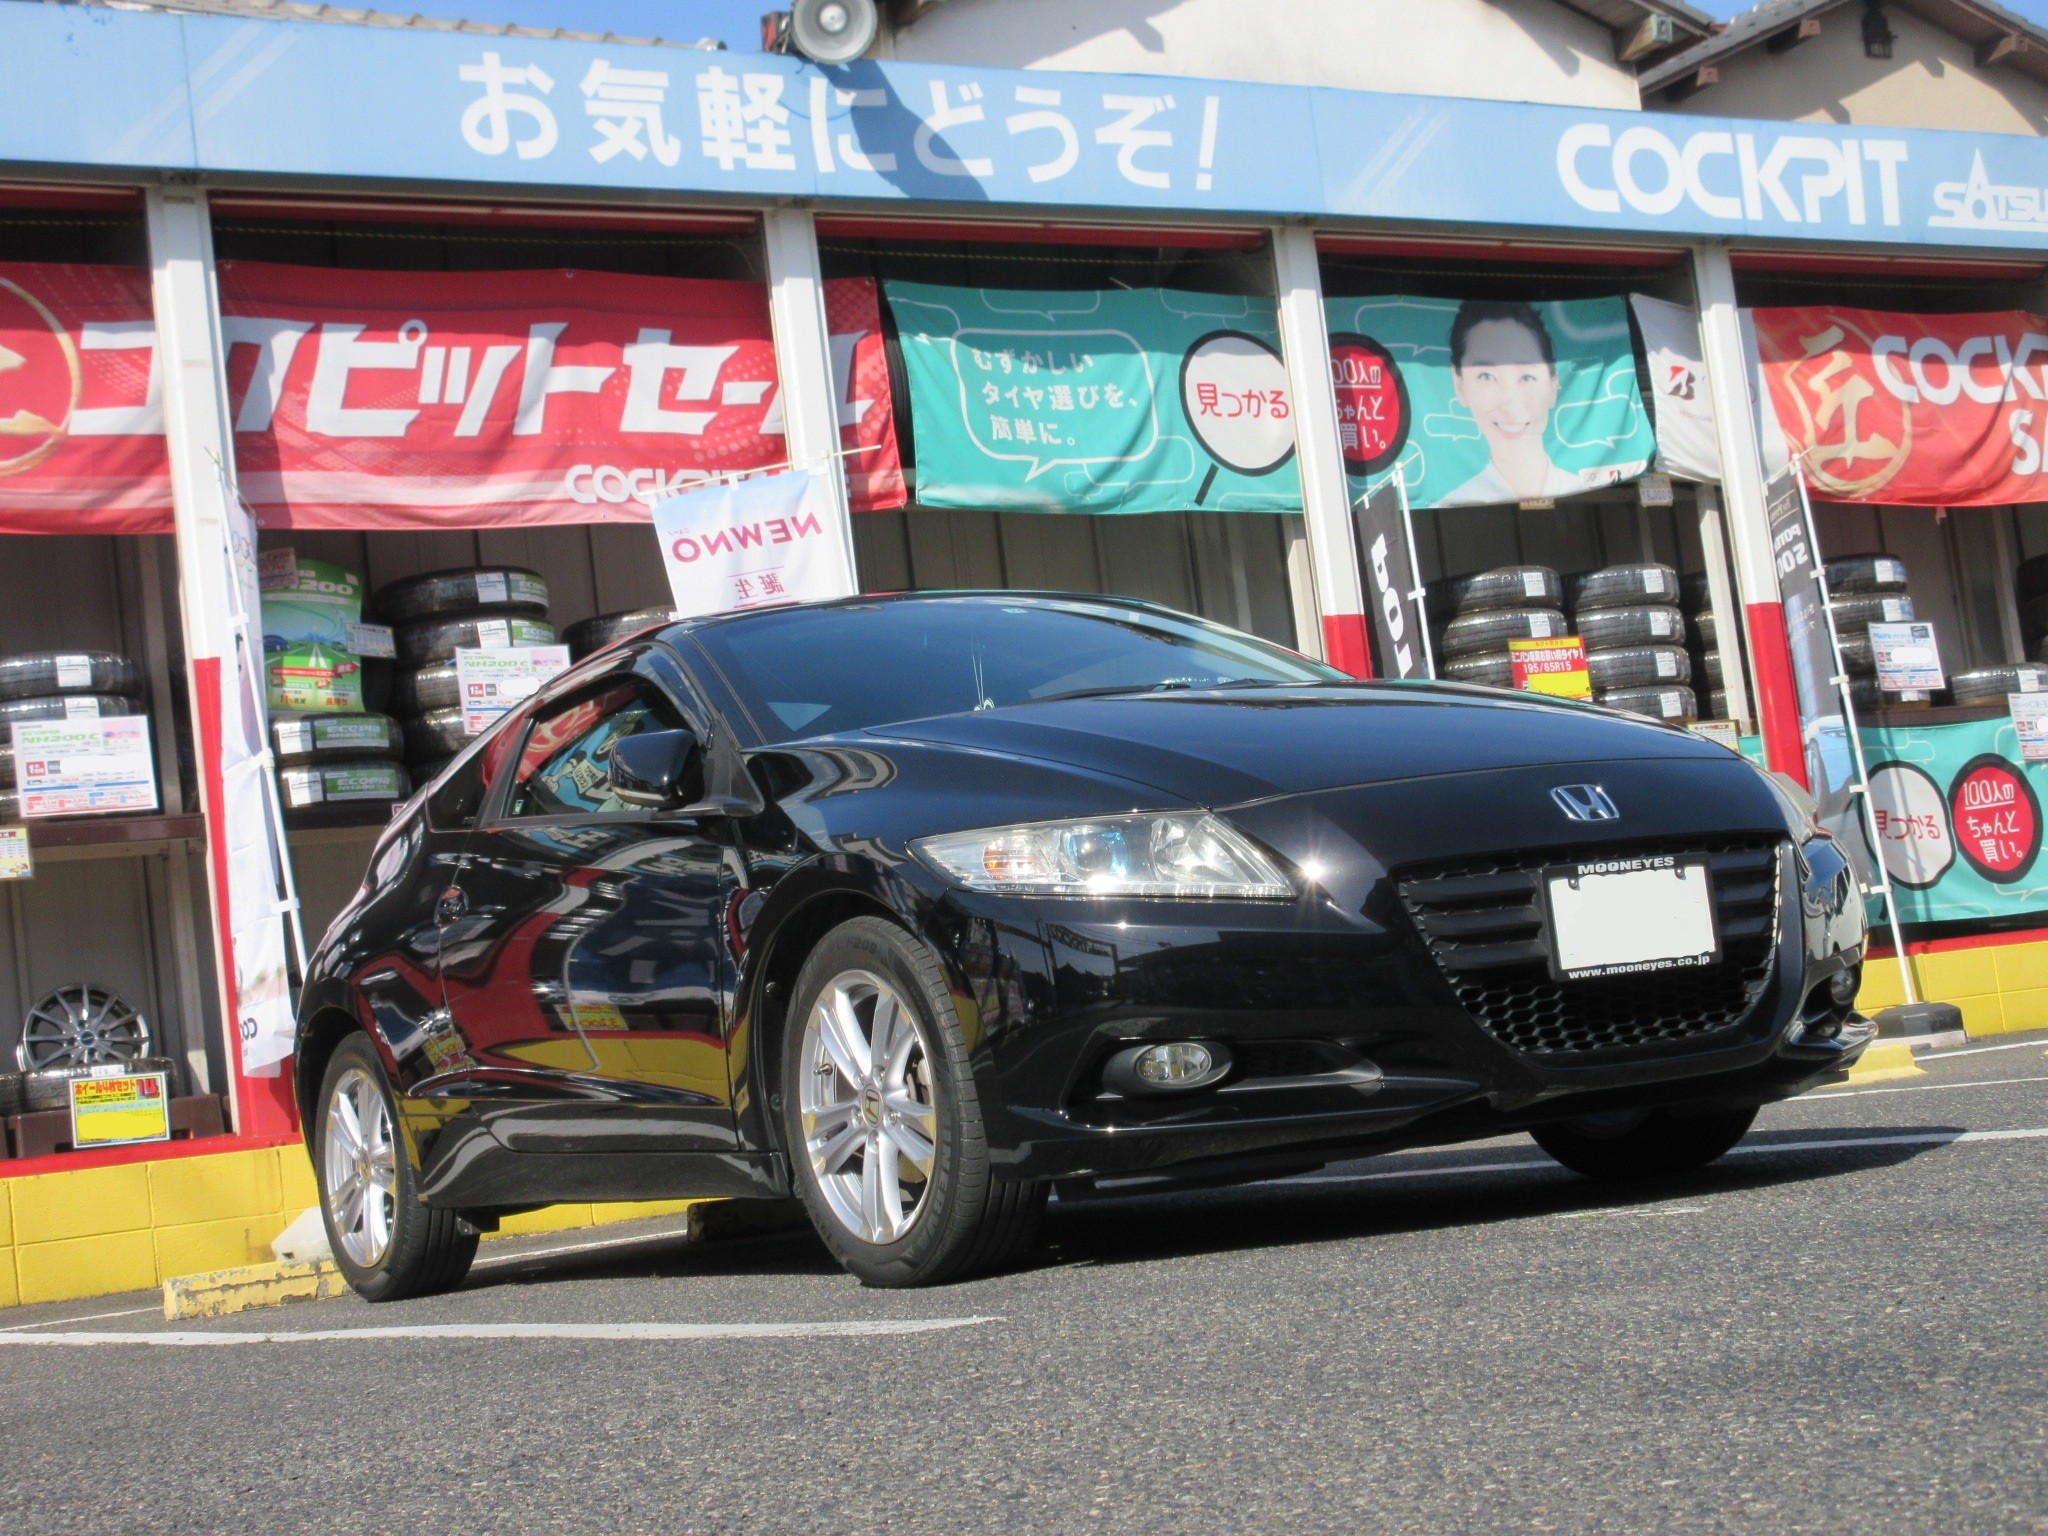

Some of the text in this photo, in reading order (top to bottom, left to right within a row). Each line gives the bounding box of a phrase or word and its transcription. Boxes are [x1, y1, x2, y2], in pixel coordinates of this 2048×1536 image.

[458, 51, 1221, 191] お気軽にどうぞ！
[1556, 122, 1909, 227] COCKPIT
[971, 347, 1095, 375] むずかしい
[1330, 358, 1381, 384] 00人の
[982, 381, 1138, 411] タイヤ選びを、
[1195, 382, 1290, 419] 見つかる
[990, 414, 1076, 447] 簡単に。
[1340, 422, 1387, 450] 買い。
[2009, 408, 2048, 476] S
[1523, 660, 1572, 674] 195/65R15
[1964, 779, 2014, 808] 100人の
[1967, 810, 2020, 838] ちゃんと
[1979, 838, 2024, 864] 買い。
[1577, 856, 1675, 875] MOONEYES
[1568, 954, 1710, 980] www.mooneyes.co.jp
